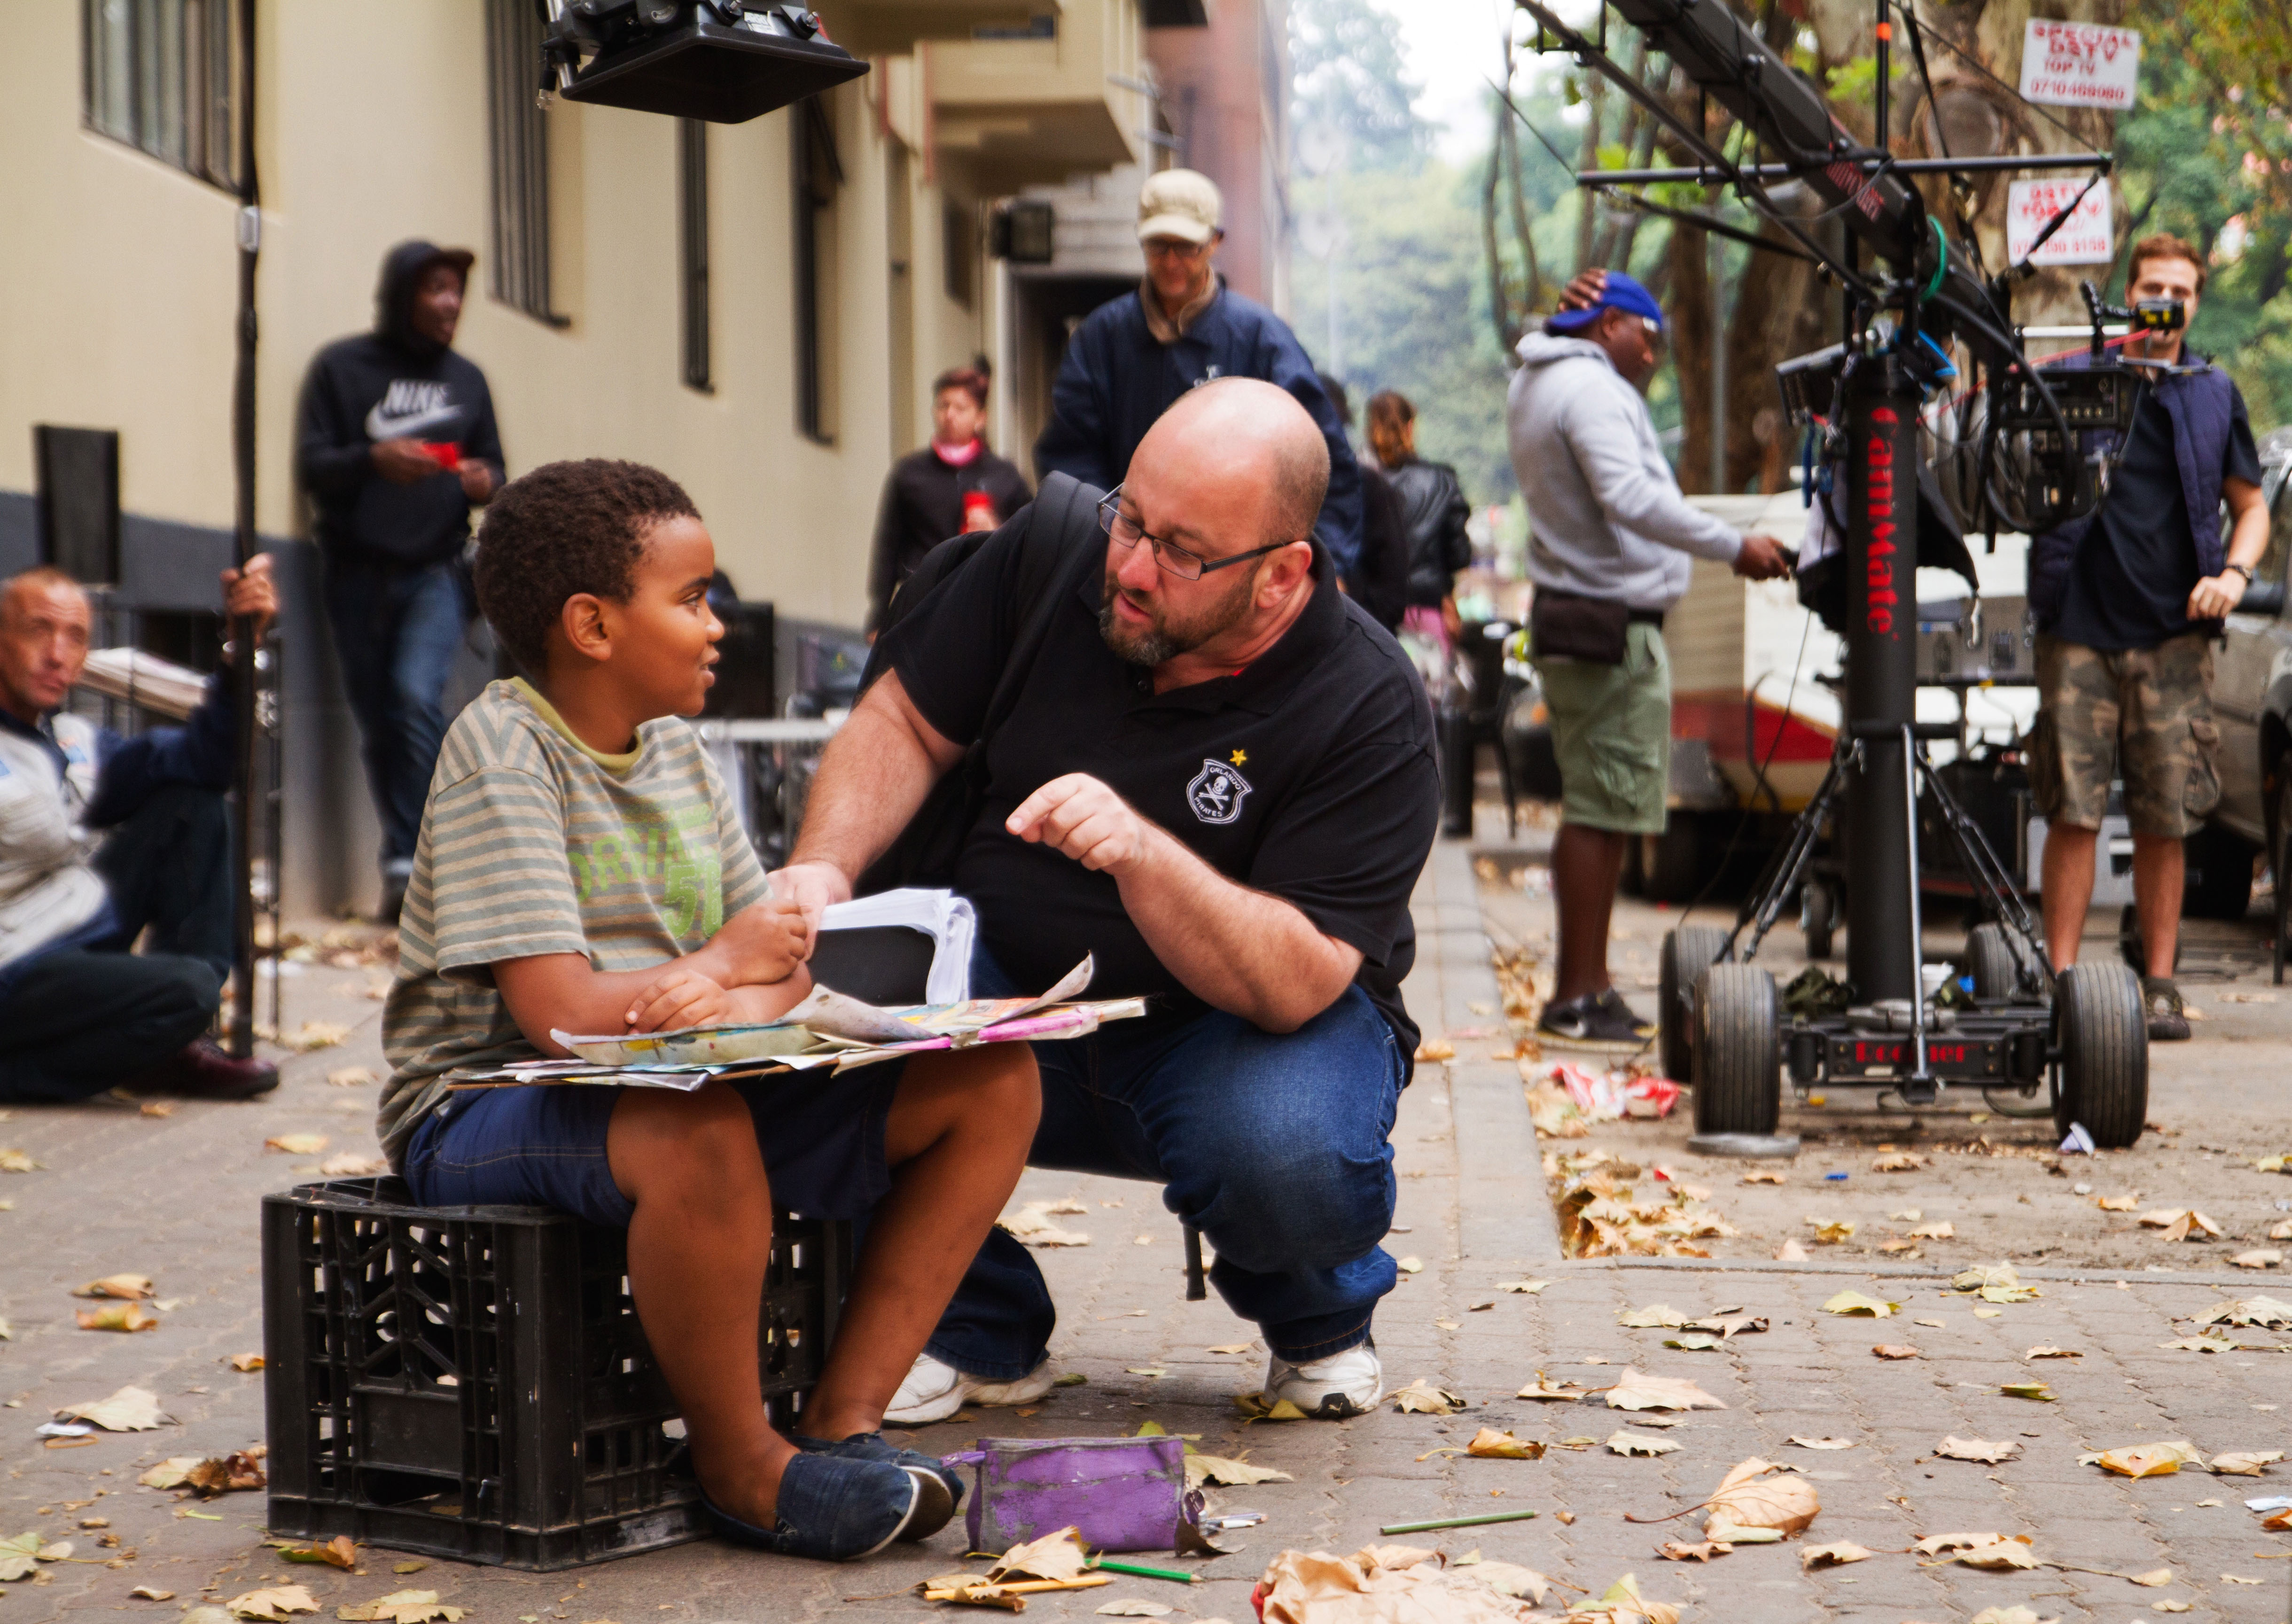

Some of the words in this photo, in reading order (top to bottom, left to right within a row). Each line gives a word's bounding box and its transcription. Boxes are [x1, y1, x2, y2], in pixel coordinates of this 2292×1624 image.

[382, 377, 448, 415] NIKE
[1209, 766, 1242, 790] ORLANDO
[1194, 796, 1223, 817] PIRATES
